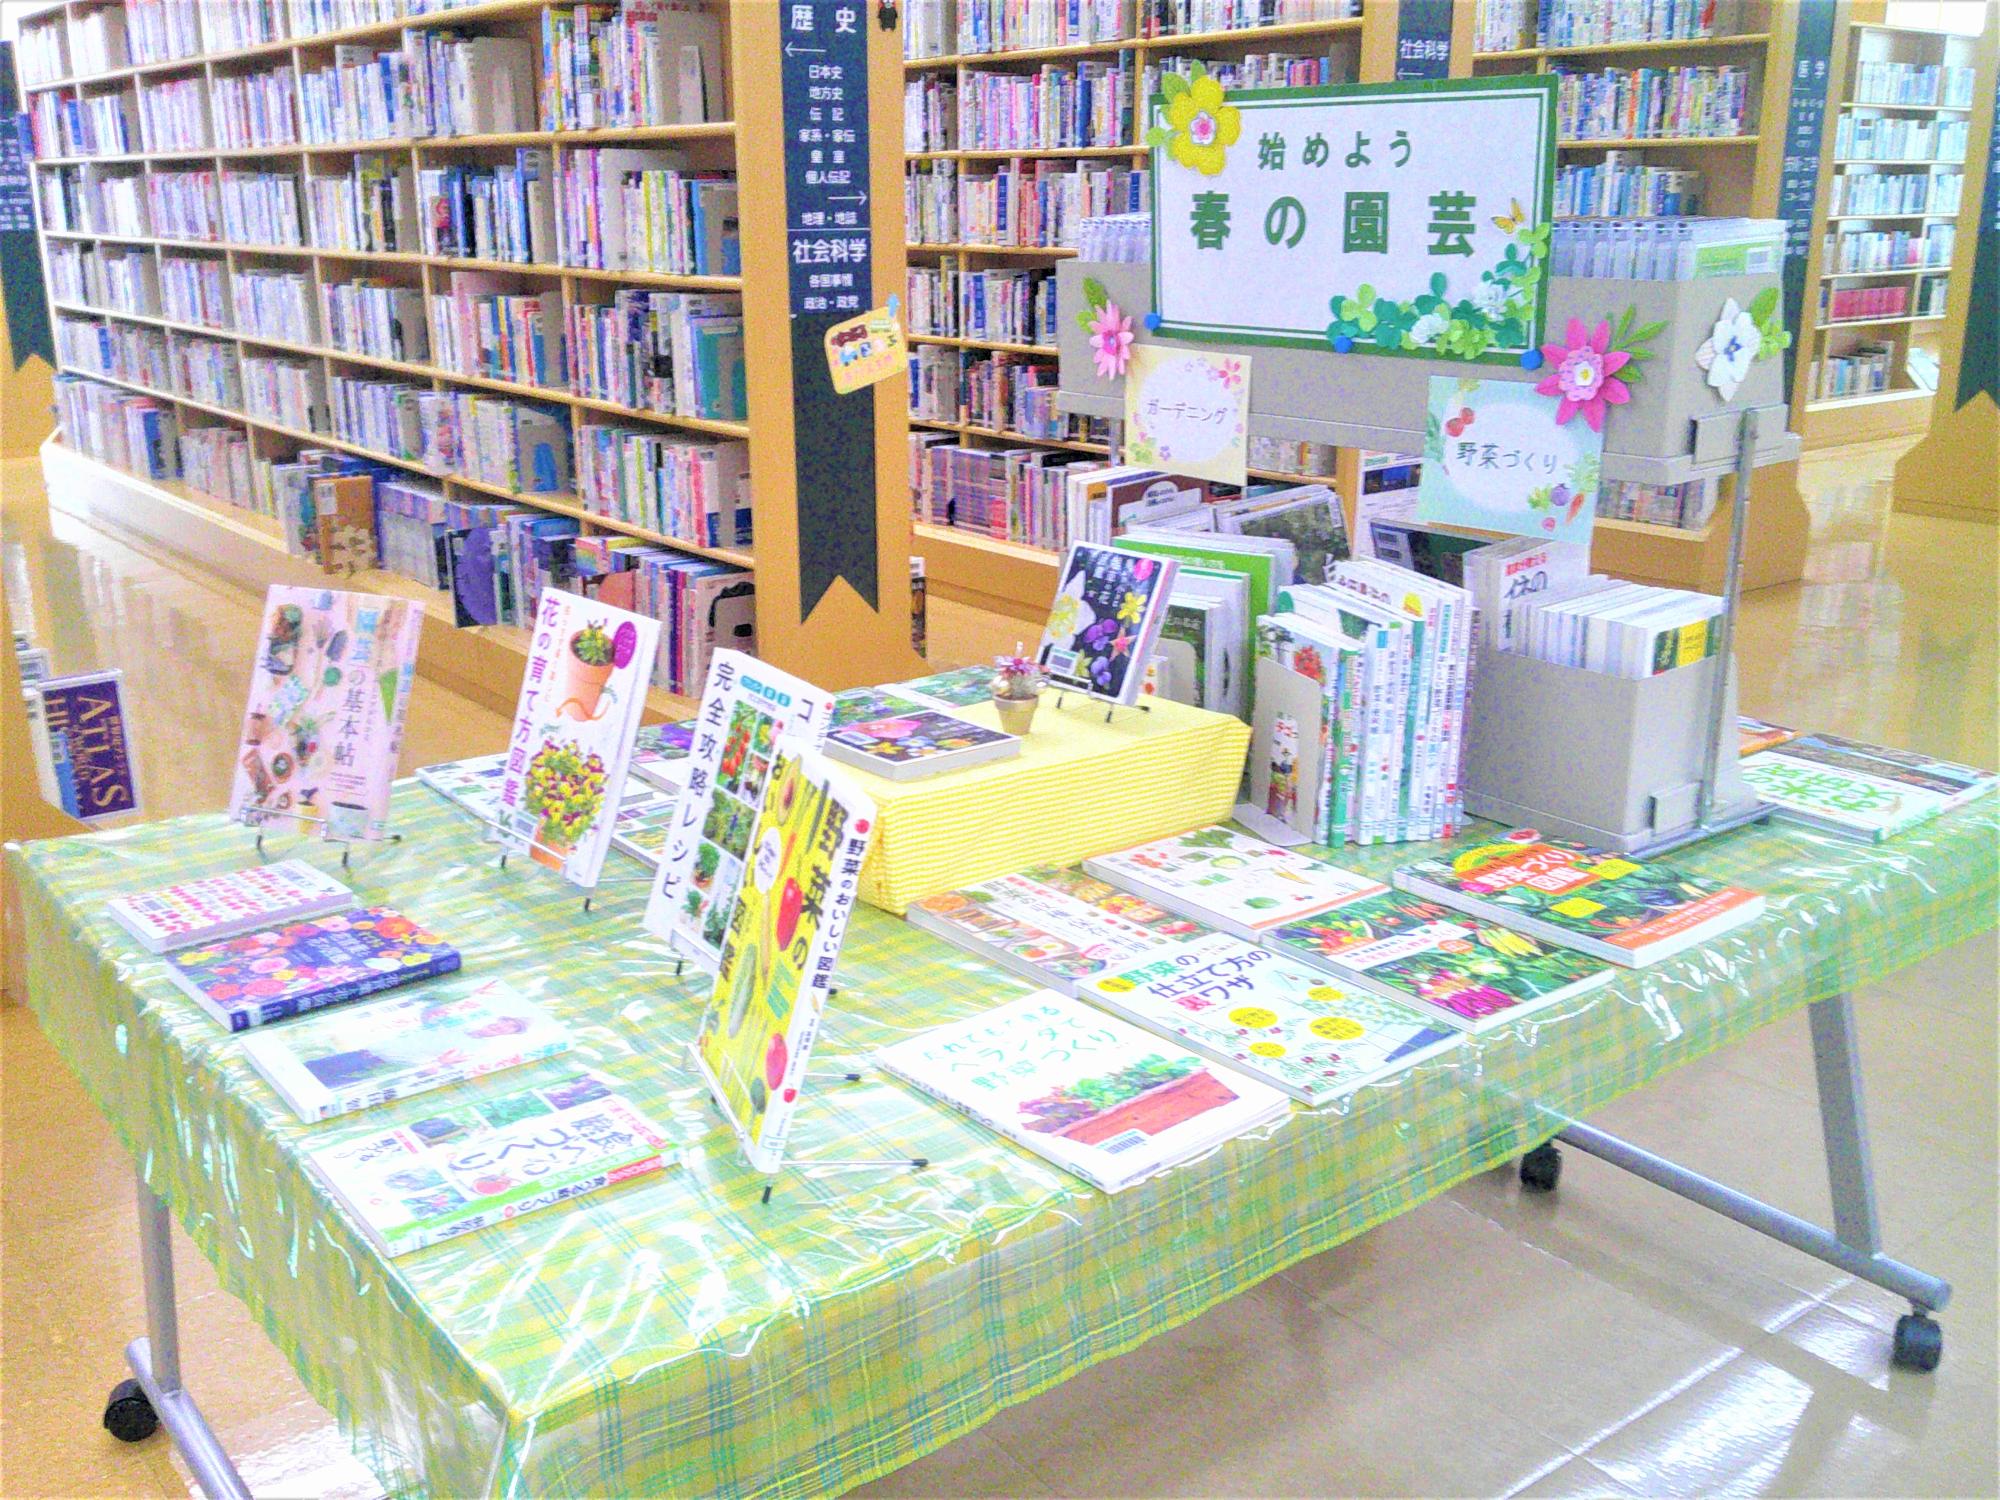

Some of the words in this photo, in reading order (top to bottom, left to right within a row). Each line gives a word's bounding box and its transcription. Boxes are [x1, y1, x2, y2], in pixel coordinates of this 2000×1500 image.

[791, 4, 857, 33] 歴史
[1399, 39, 1449, 61] 社会科学
[808, 64, 844, 80] 日本史
[808, 86, 844, 101] 地方史
[1257, 131, 1414, 171] 始めよう
[1189, 190, 1477, 258] 春の園芸
[792, 238, 868, 264] 社会科学
[1146, 398, 1229, 425] ガーデニング
[1456, 441, 1558, 474] 野菜づくり
[78, 695, 130, 807] ATLAS
[662, 661, 736, 899] 完全攻略レシピ
[792, 798, 850, 970] 野菜の
[1474, 849, 1578, 889] 野菜づくり
[811, 838, 867, 990] 野菜のおいしい図鑑
[1121, 953, 1199, 985] 野菜の
[1146, 948, 1273, 999] 仕立て方の
[1174, 976, 1256, 1012] 裏ワザ
